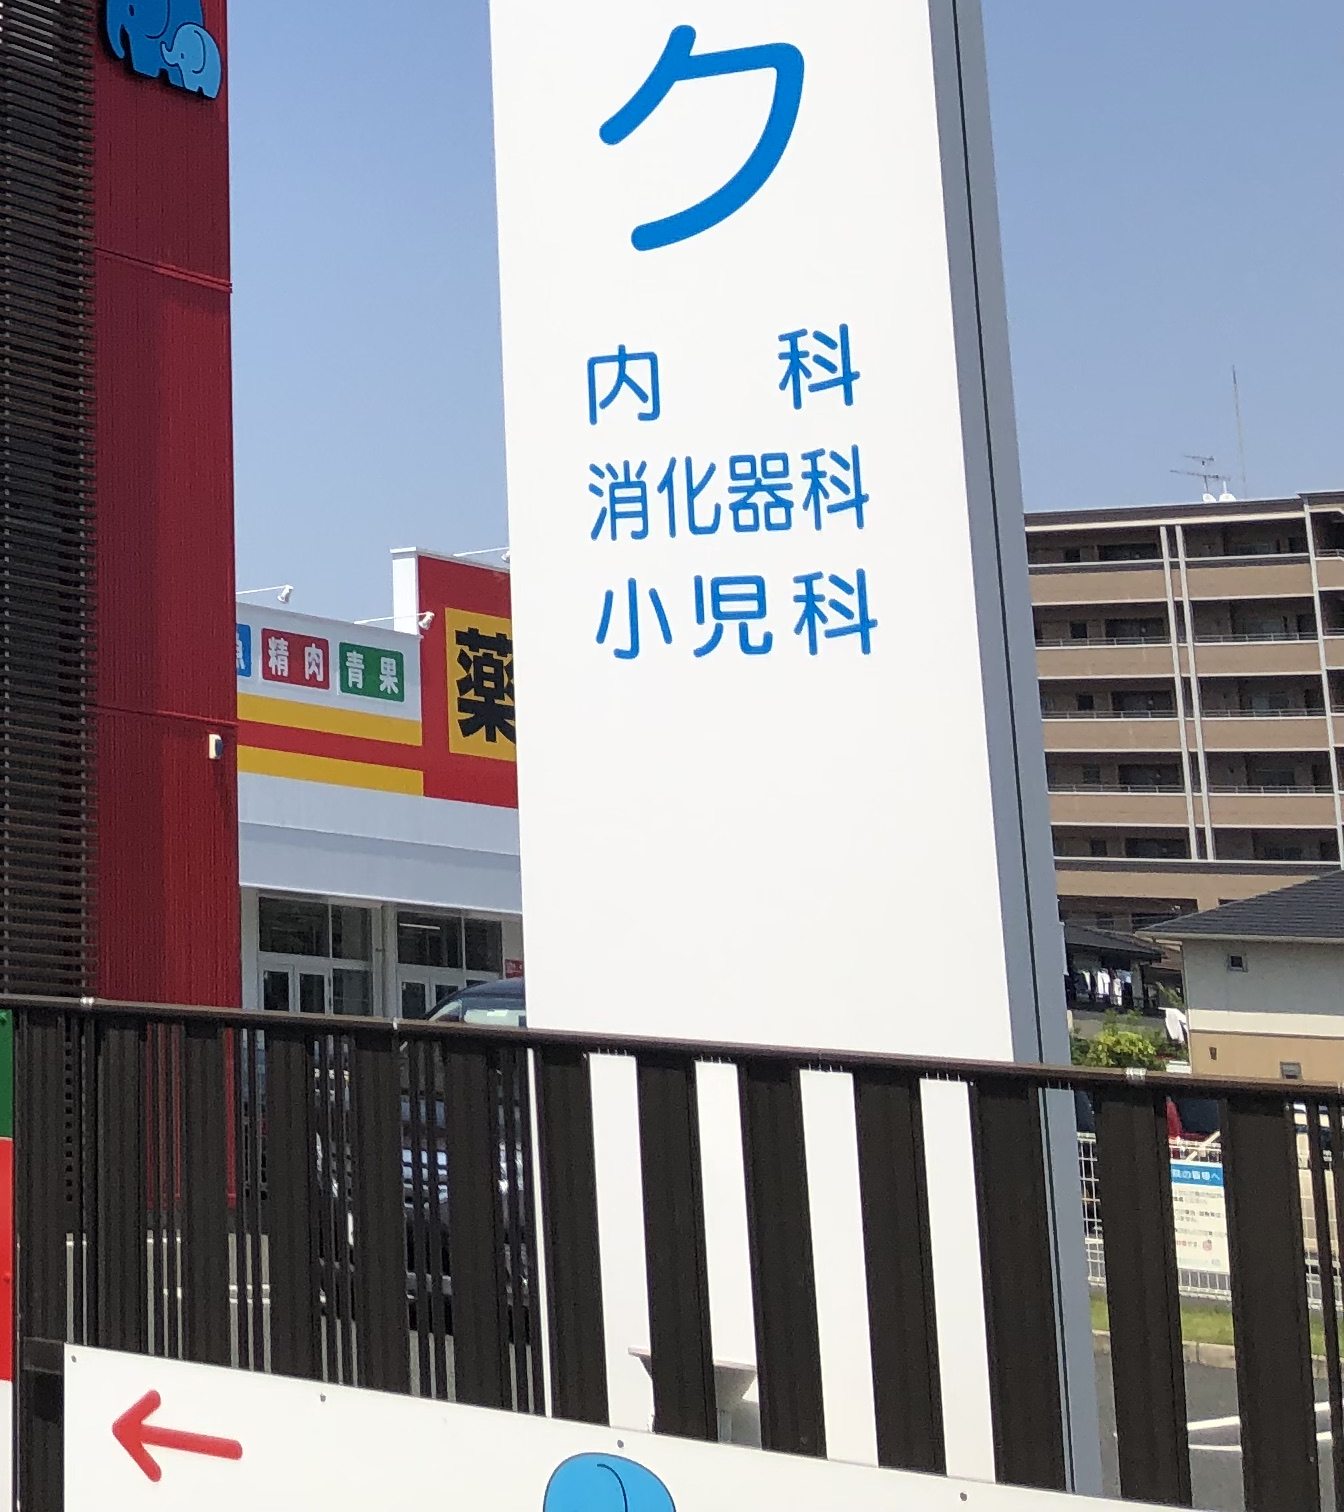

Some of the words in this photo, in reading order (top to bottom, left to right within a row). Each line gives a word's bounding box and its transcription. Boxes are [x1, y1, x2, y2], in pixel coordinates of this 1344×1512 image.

[587, 323, 860, 425] 内科
[588, 444, 869, 541] 消化器科
[596, 568, 878, 659] 小児科
